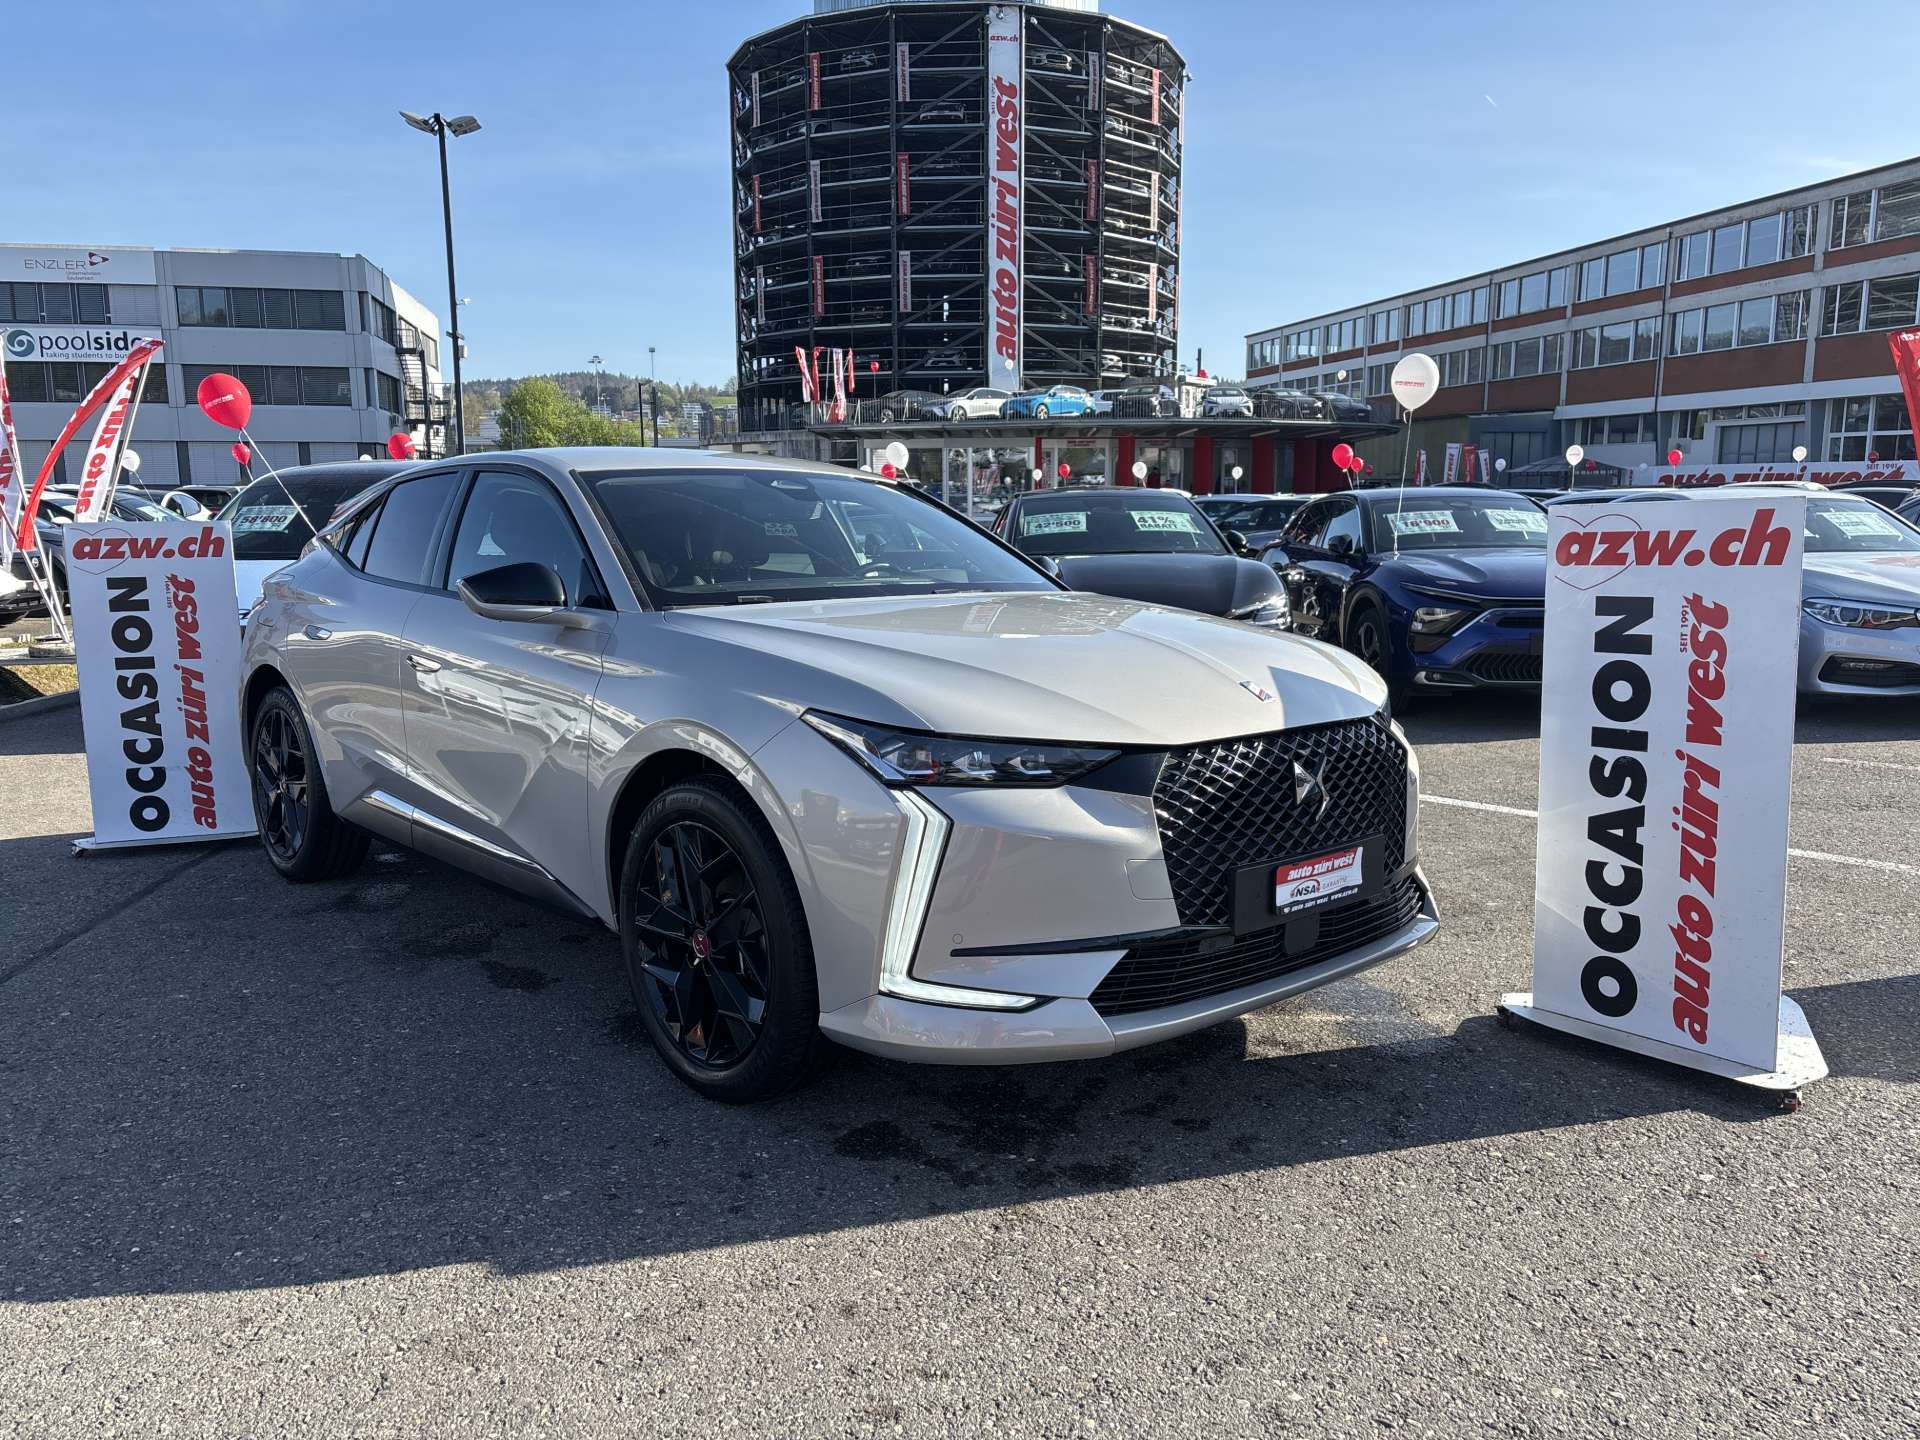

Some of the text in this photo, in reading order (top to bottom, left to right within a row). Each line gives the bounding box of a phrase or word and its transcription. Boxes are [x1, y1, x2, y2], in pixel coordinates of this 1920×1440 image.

[990, 34, 1018, 42] azw.ch
[991, 75, 1018, 360] auto züri west
[24, 259, 86, 270] ENZLER
[45, 352, 70, 360] taking
[71, 351, 104, 359] students
[73, 527, 225, 560] azw.ch
[1556, 508, 1791, 566] azw.ch
[1680, 604, 1689, 653] SEIT 1991
[106, 576, 170, 832] OCCASION
[165, 573, 217, 830] auto züri west
[1580, 595, 1654, 1018] OCCASION
[1669, 592, 1729, 1045] auto züri west
[1288, 854, 1355, 881] auto züri west
[1295, 884, 1316, 898] NSA
